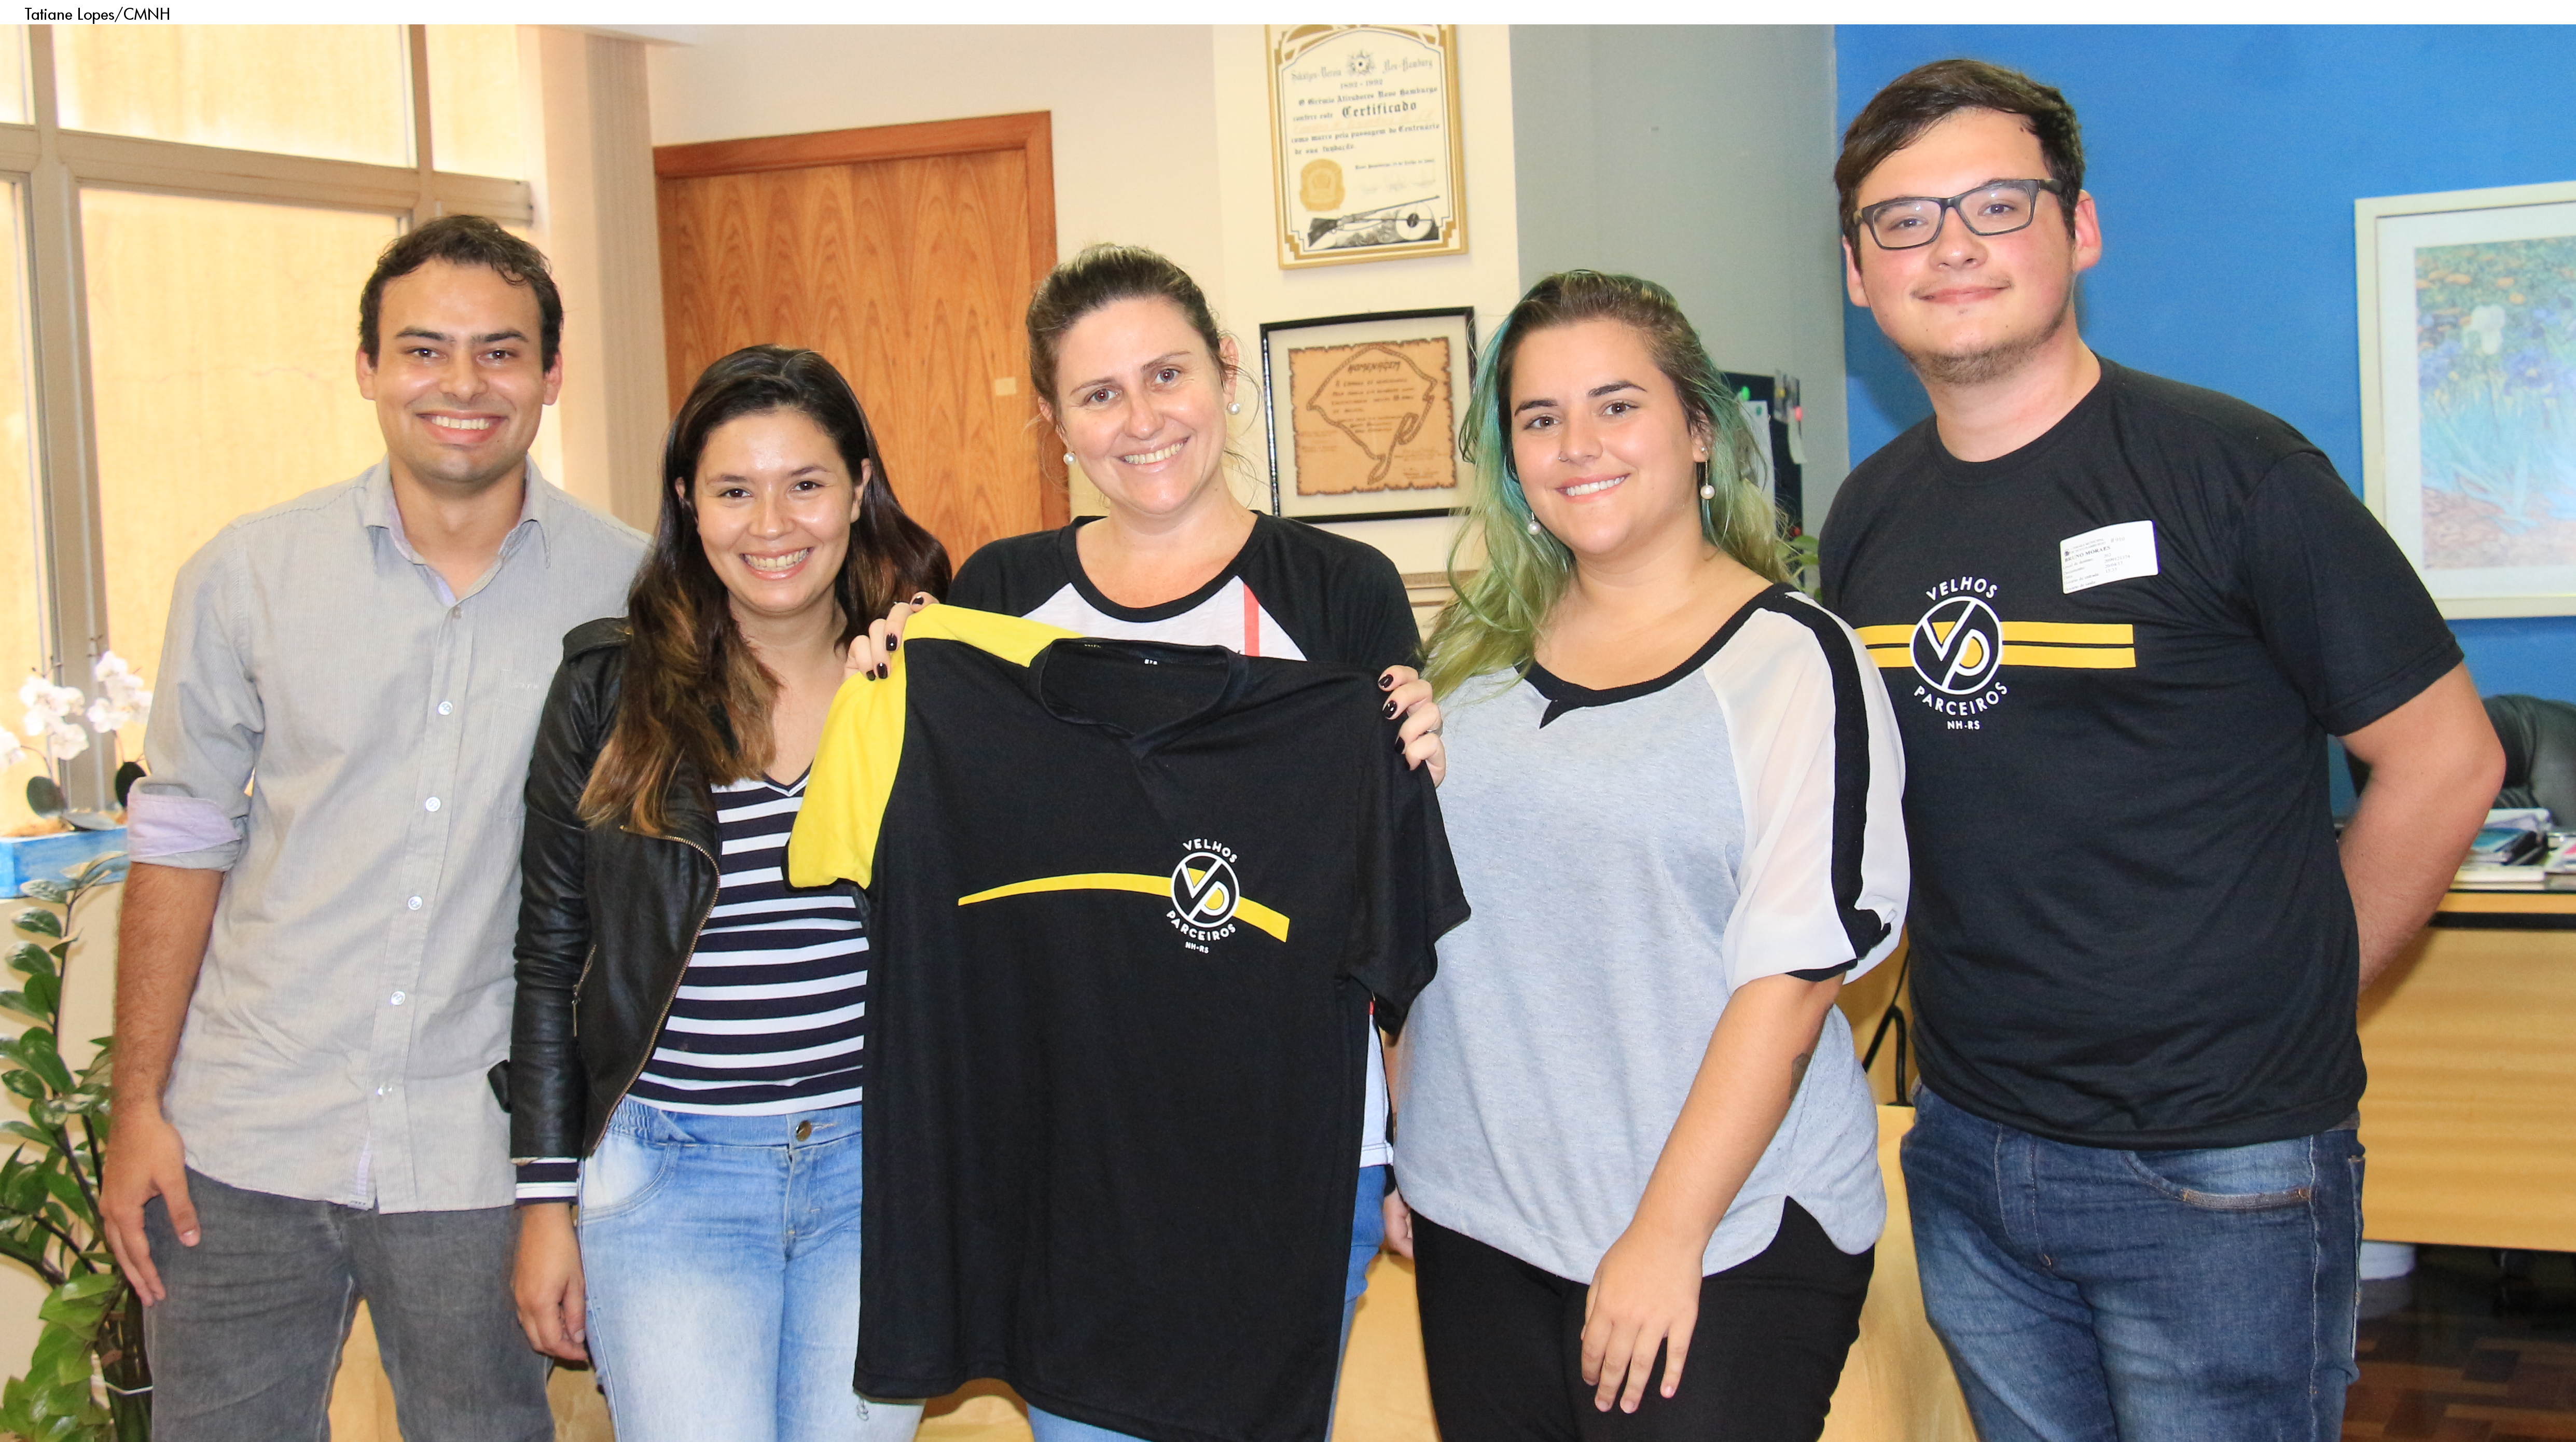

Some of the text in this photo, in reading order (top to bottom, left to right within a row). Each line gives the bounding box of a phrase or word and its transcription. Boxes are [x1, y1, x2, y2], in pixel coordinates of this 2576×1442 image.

[1365, 78, 1383, 87] 1992
[1400, 87, 1438, 96] Hamburgo
[1342, 101, 1417, 118] Certificado
[2065, 546, 2111, 562] BRUNO MORAES
[1926, 576, 1998, 601] VELHOS
[1913, 681, 2009, 716] PARCEIROS
[1182, 838, 1238, 864] VELHOS
[1166, 910, 1237, 941] PARCEIROS
